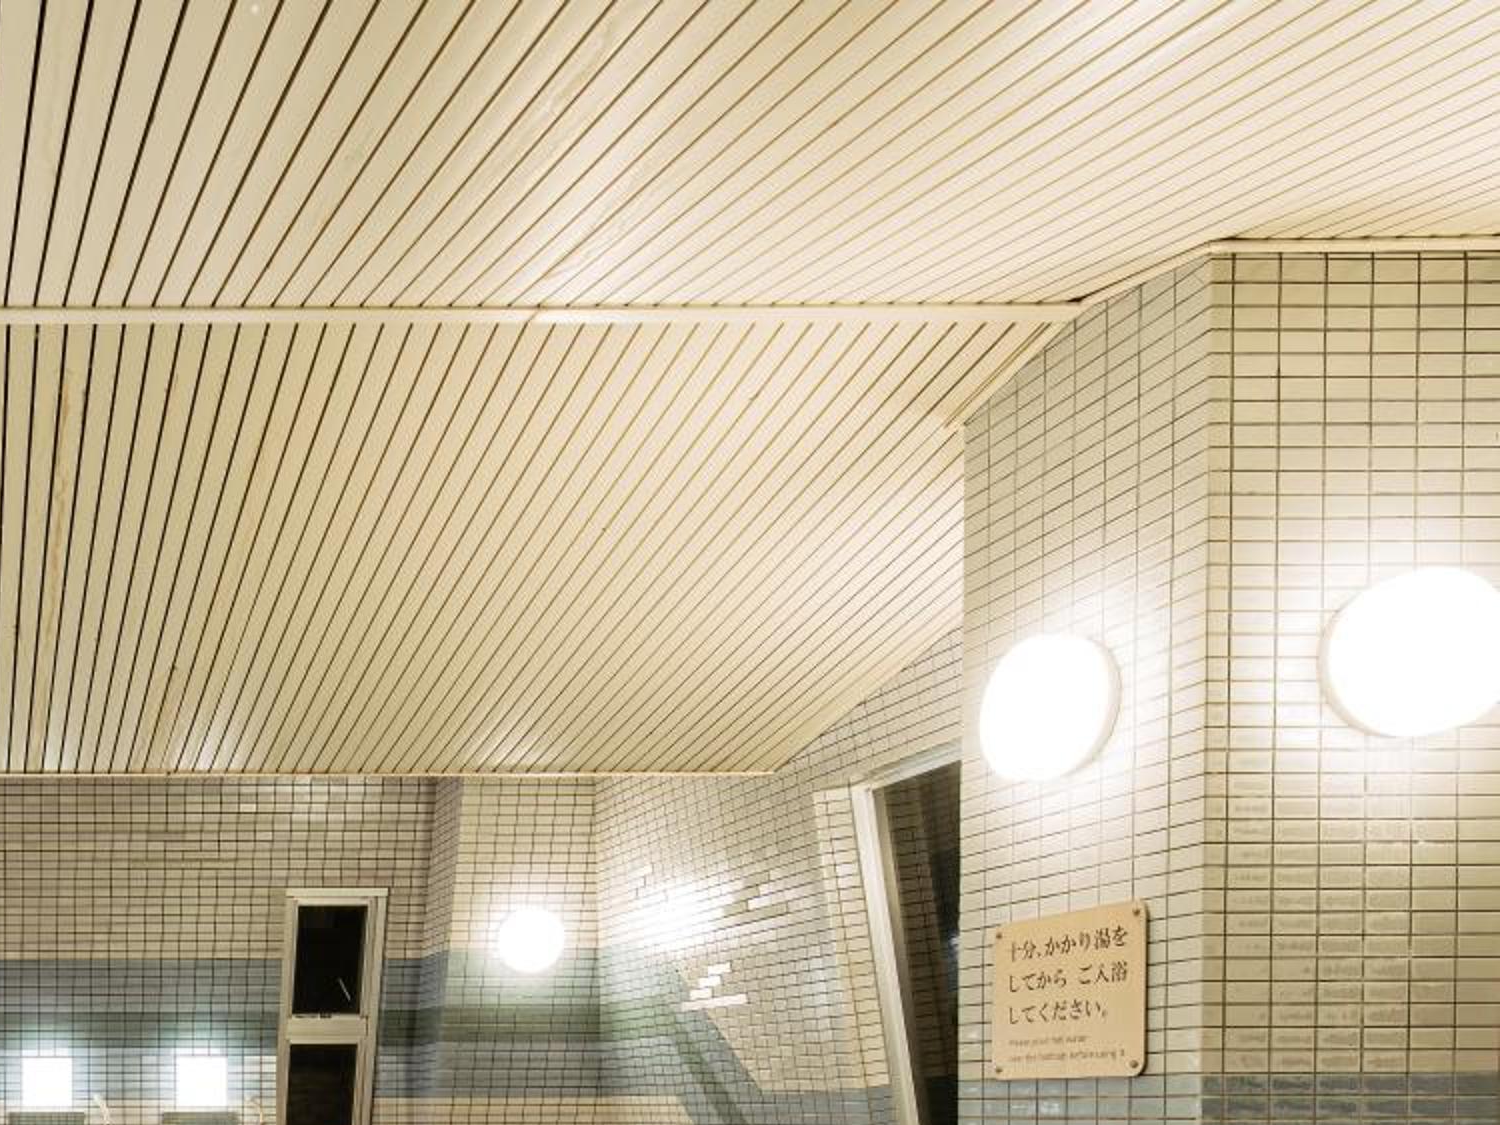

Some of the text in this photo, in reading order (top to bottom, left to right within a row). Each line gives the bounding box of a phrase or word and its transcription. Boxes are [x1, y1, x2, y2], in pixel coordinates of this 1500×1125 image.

[1008, 999, 1108, 1025] してください。
